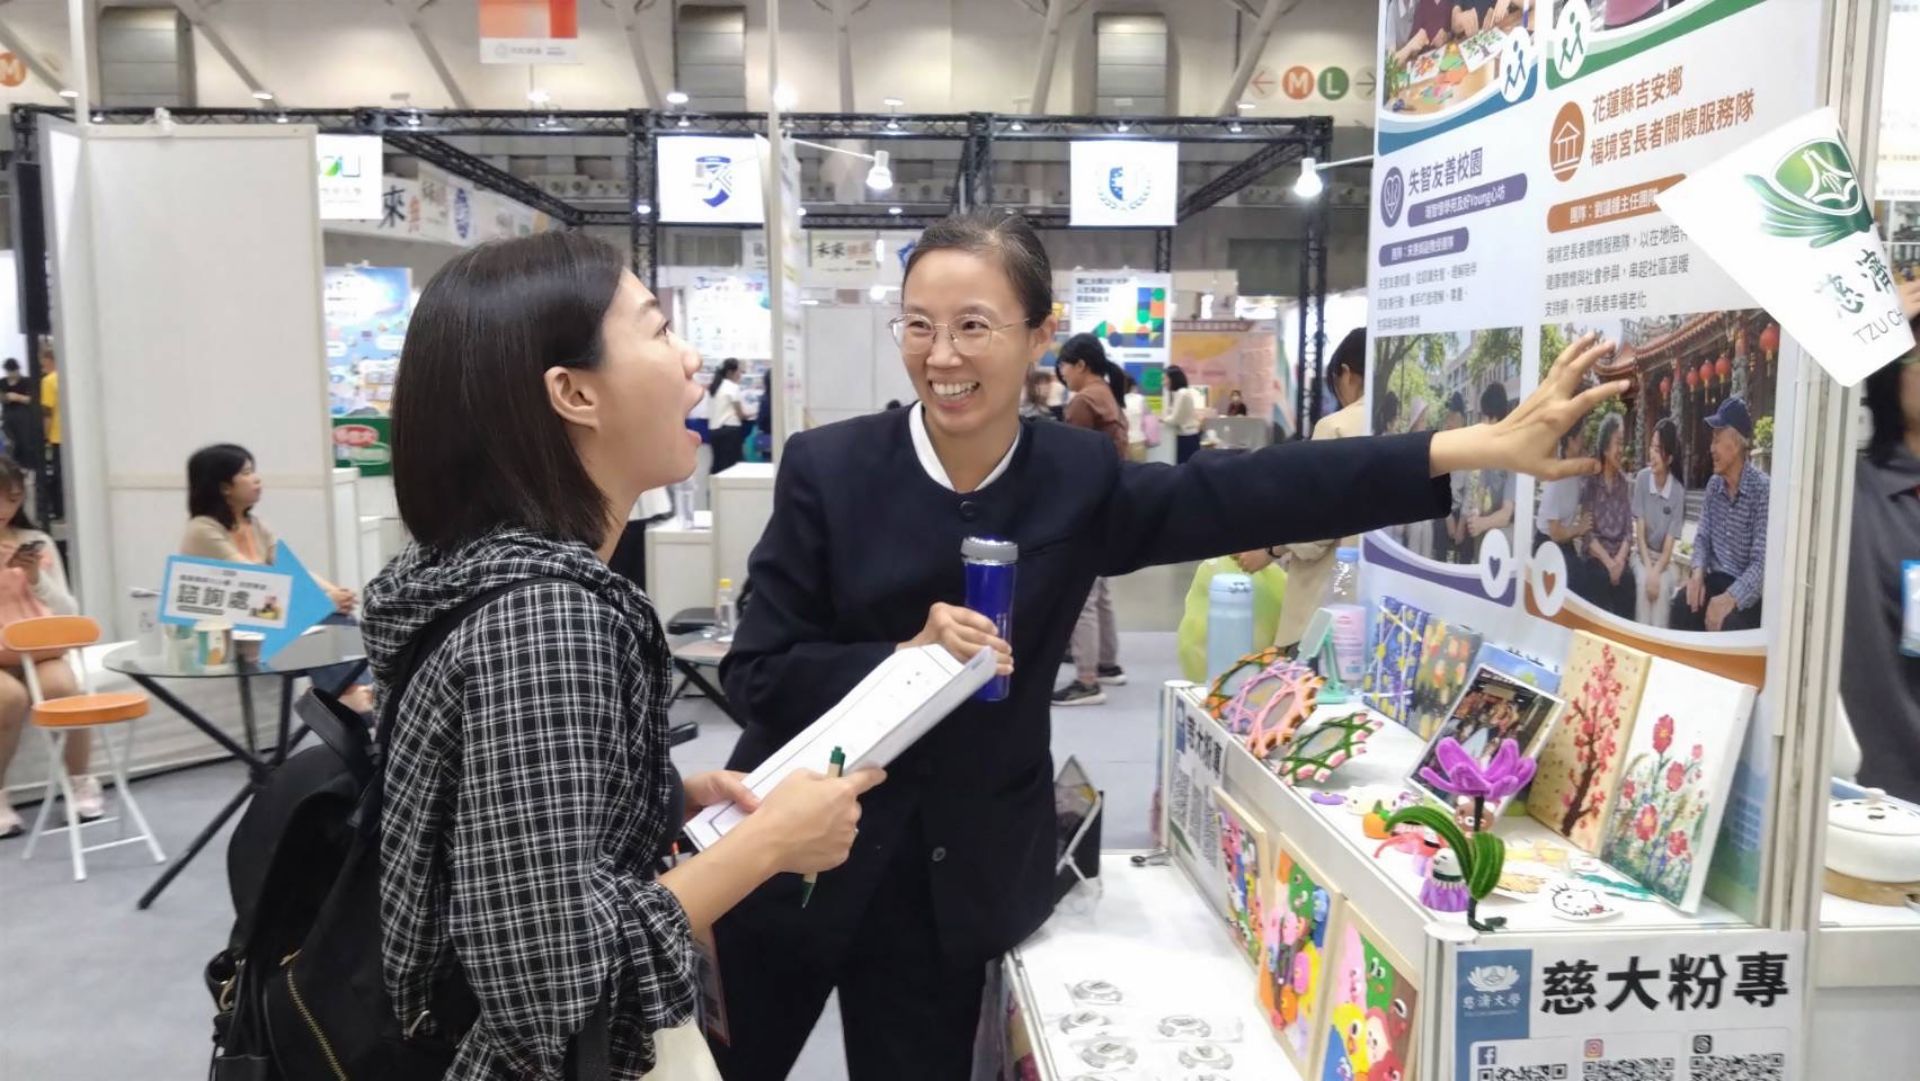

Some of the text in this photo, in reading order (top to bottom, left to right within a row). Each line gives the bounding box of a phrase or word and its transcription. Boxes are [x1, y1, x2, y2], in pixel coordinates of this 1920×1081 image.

[1288, 71, 1341, 95] M L
[1592, 65, 1683, 124] 花蓮縣吉安鄉
[1591, 88, 1755, 166] 福境宮長者關懷服務隊
[1408, 147, 1483, 196] 失智友善校園
[1852, 317, 1889, 344] TZU
[1540, 951, 1788, 1015] 慈大粉專
